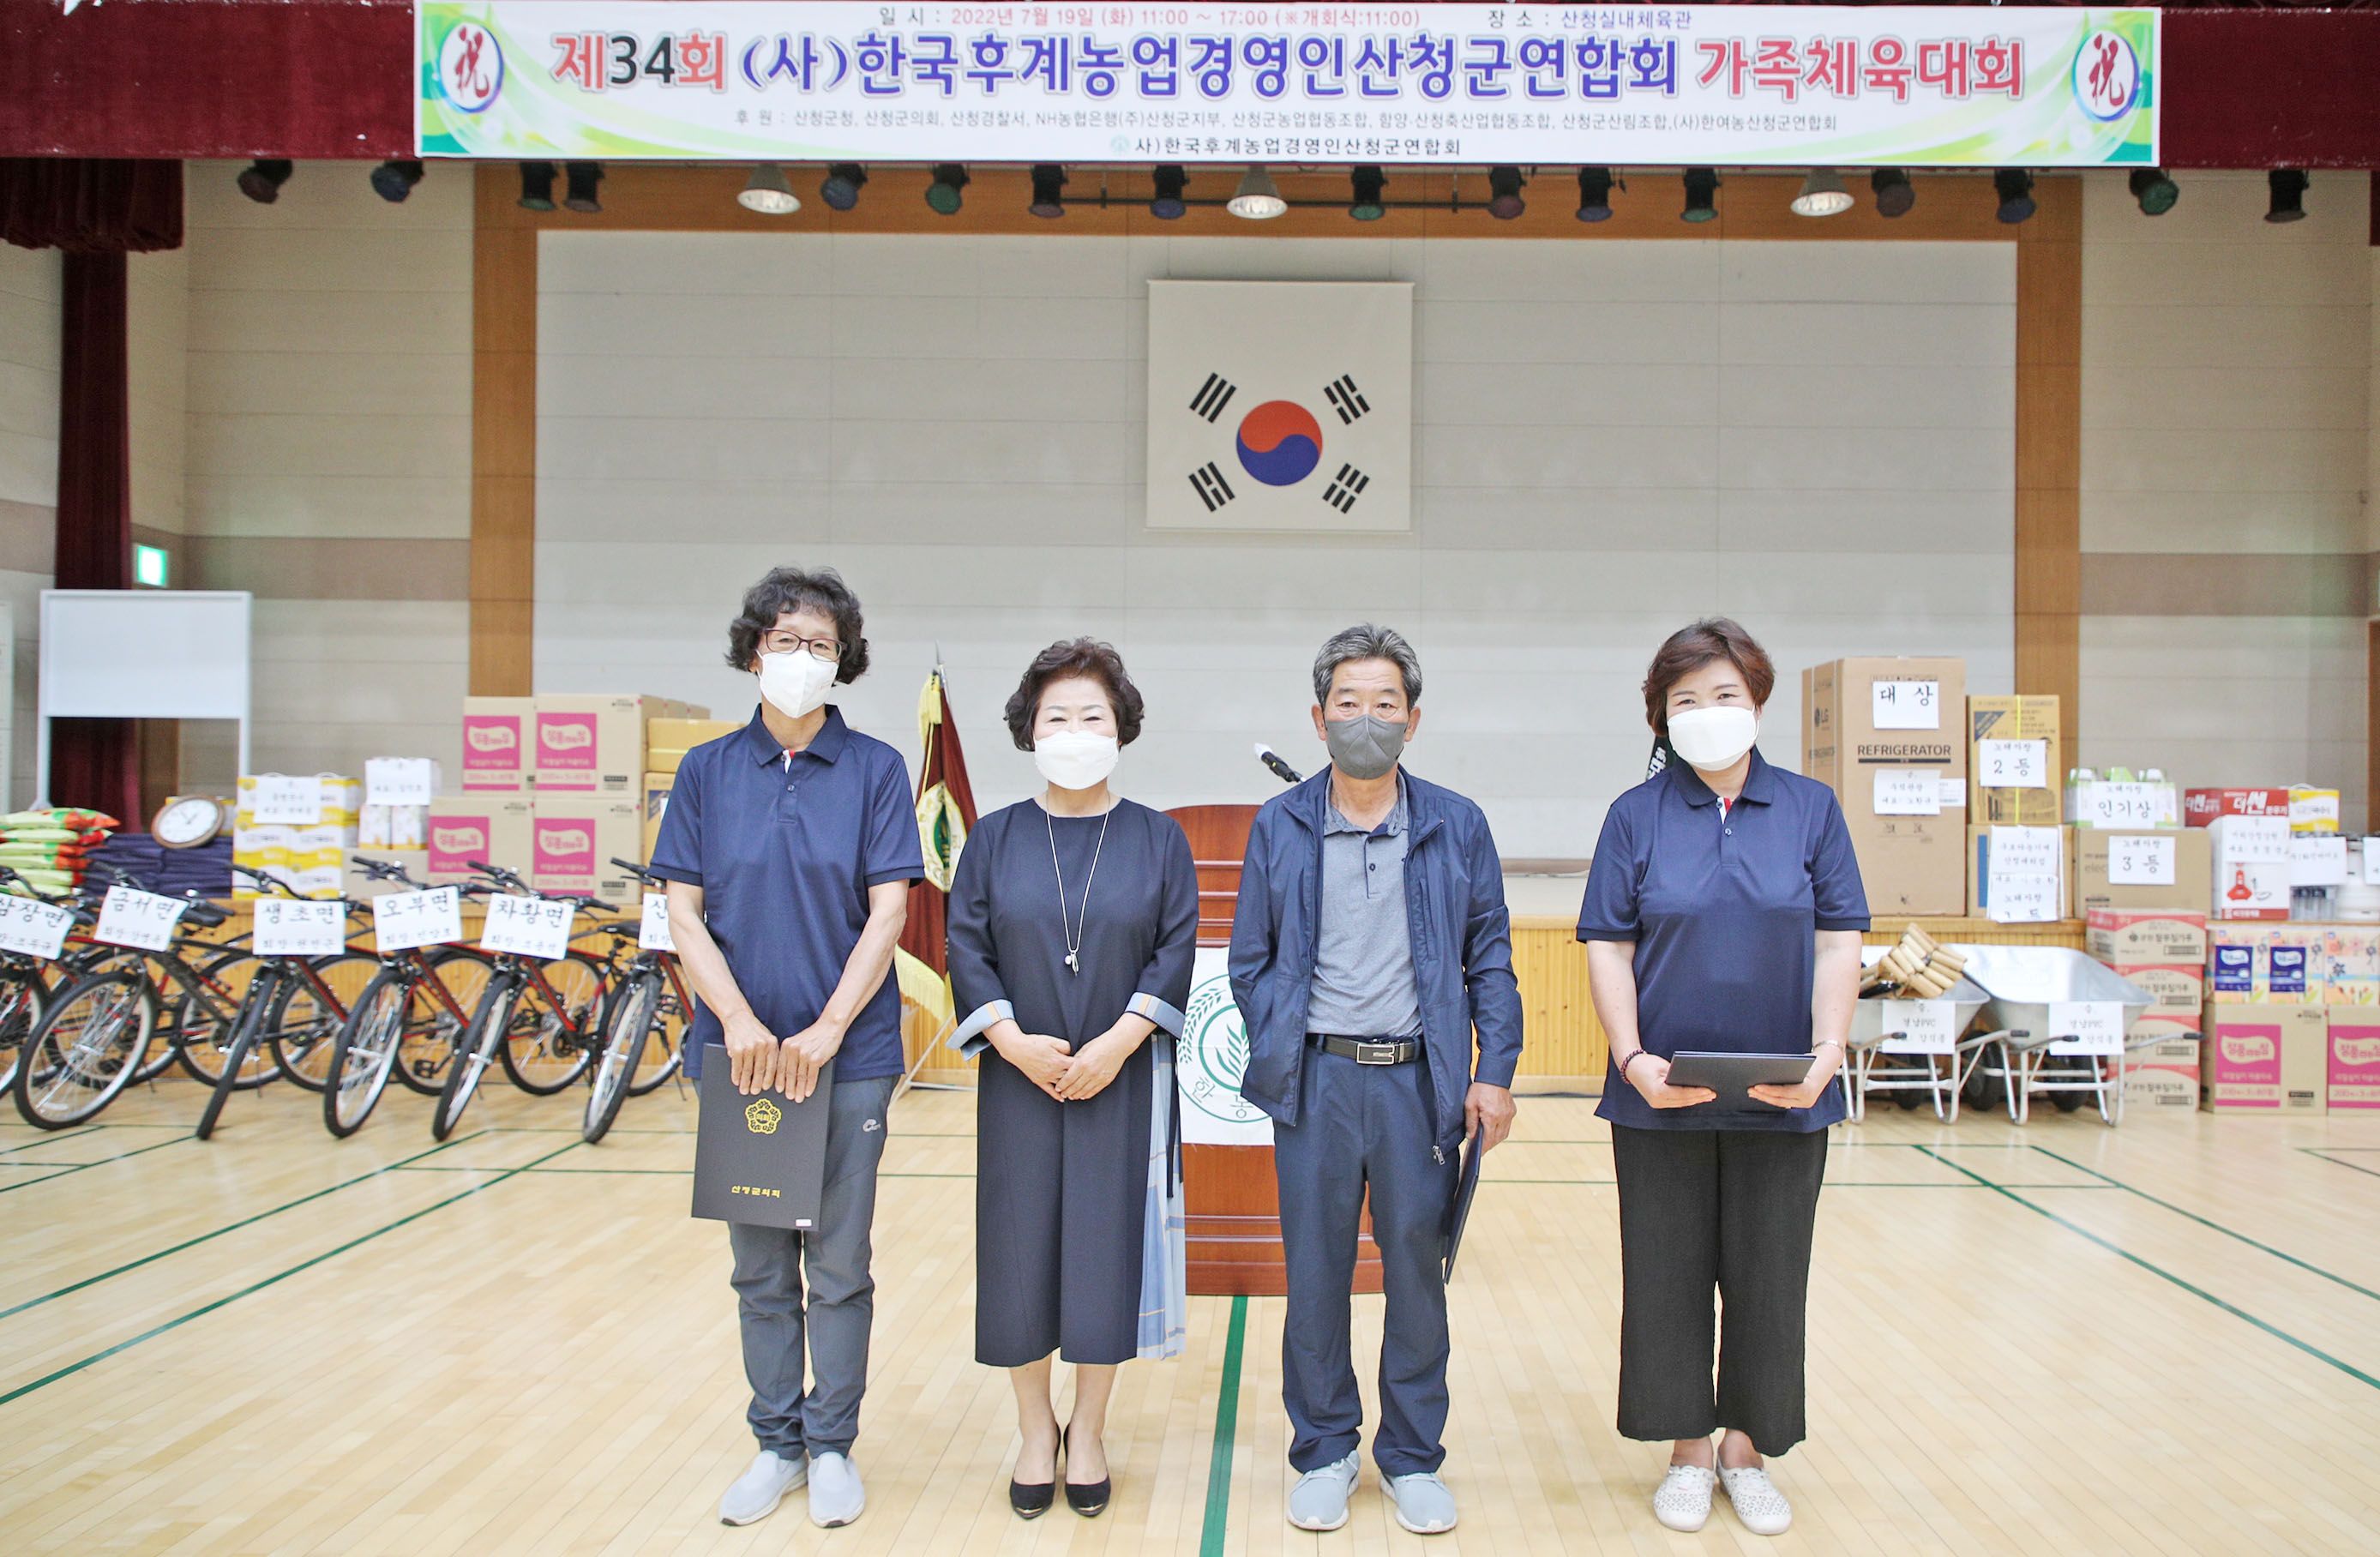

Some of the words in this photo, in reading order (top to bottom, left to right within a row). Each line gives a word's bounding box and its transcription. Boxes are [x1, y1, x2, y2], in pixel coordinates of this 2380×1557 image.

[951, 8, 1013, 27] 2022년
[1021, 9, 1049, 27] 7월
[1056, 9, 1094, 27] 19일
[1101, 8, 1133, 27] (화)
[1142, 9, 1188, 26] 11:00
[1220, 9, 1268, 27] 17:00
[1560, 9, 1692, 30] 산청실내체육관
[553, 33, 725, 91] 제34회
[742, 33, 1678, 99] (사)한국후계농업경영인산청군연합회
[1696, 36, 2022, 101] 가족체육대회
[1857, 744, 1952, 756] REFRIGERATOR
[2098, 799, 2152, 818] 인기상
[111, 891, 177, 921] 금서면
[381, 891, 448, 918] 오부면
[496, 899, 566, 929] 차황면
